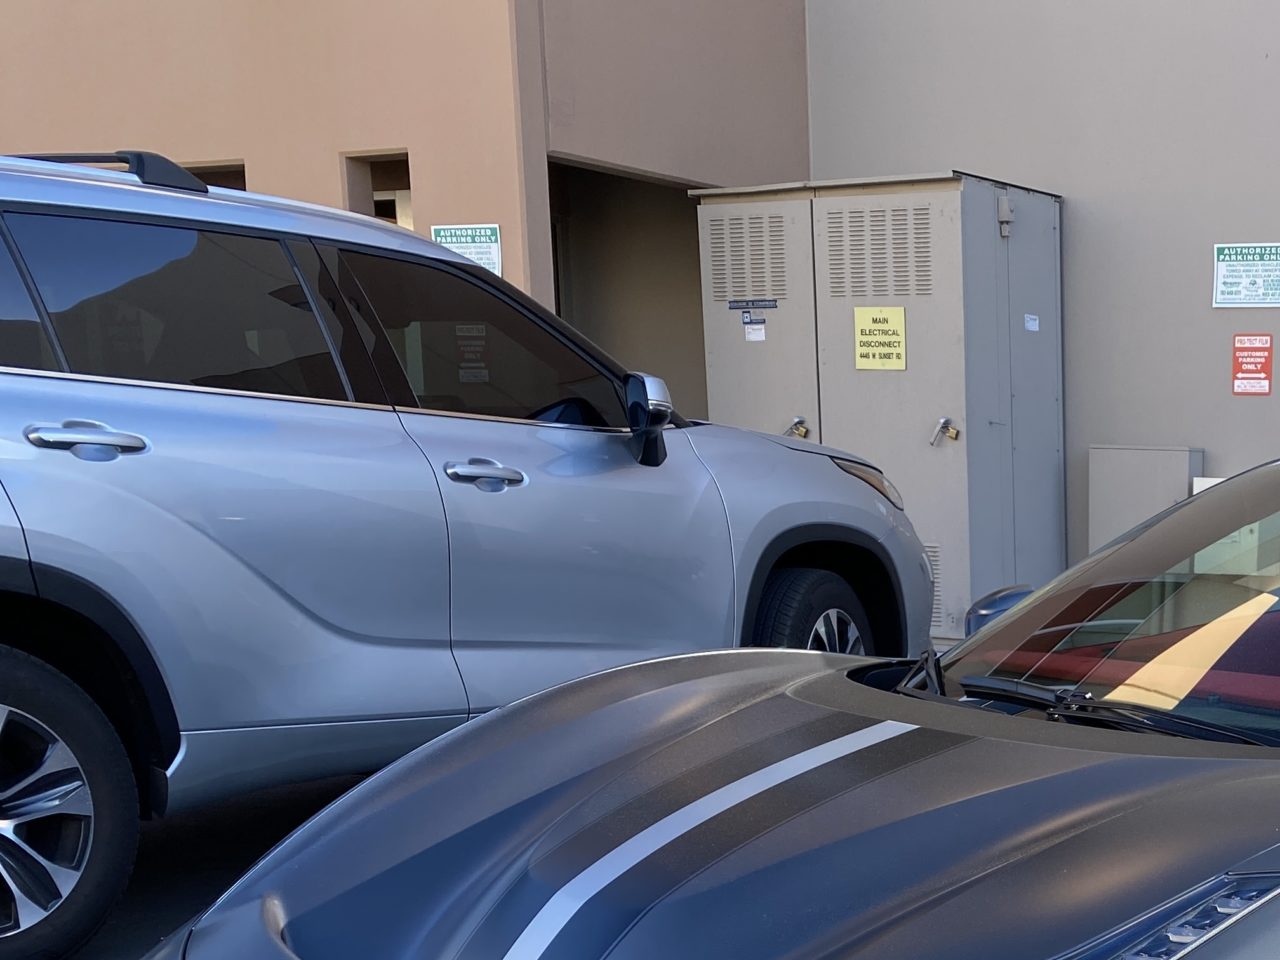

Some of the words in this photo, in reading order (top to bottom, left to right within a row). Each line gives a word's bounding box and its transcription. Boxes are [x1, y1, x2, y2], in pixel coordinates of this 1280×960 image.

[440, 228, 492, 236] AUTHORIZED
[437, 236, 471, 244] PARKING
[474, 235, 496, 243] ONLY
[871, 317, 889, 325] MAIN
[860, 328, 901, 336] ELECTRICAL
[859, 340, 901, 348] DISCONNECT
[878, 352, 894, 360] SUNSET
